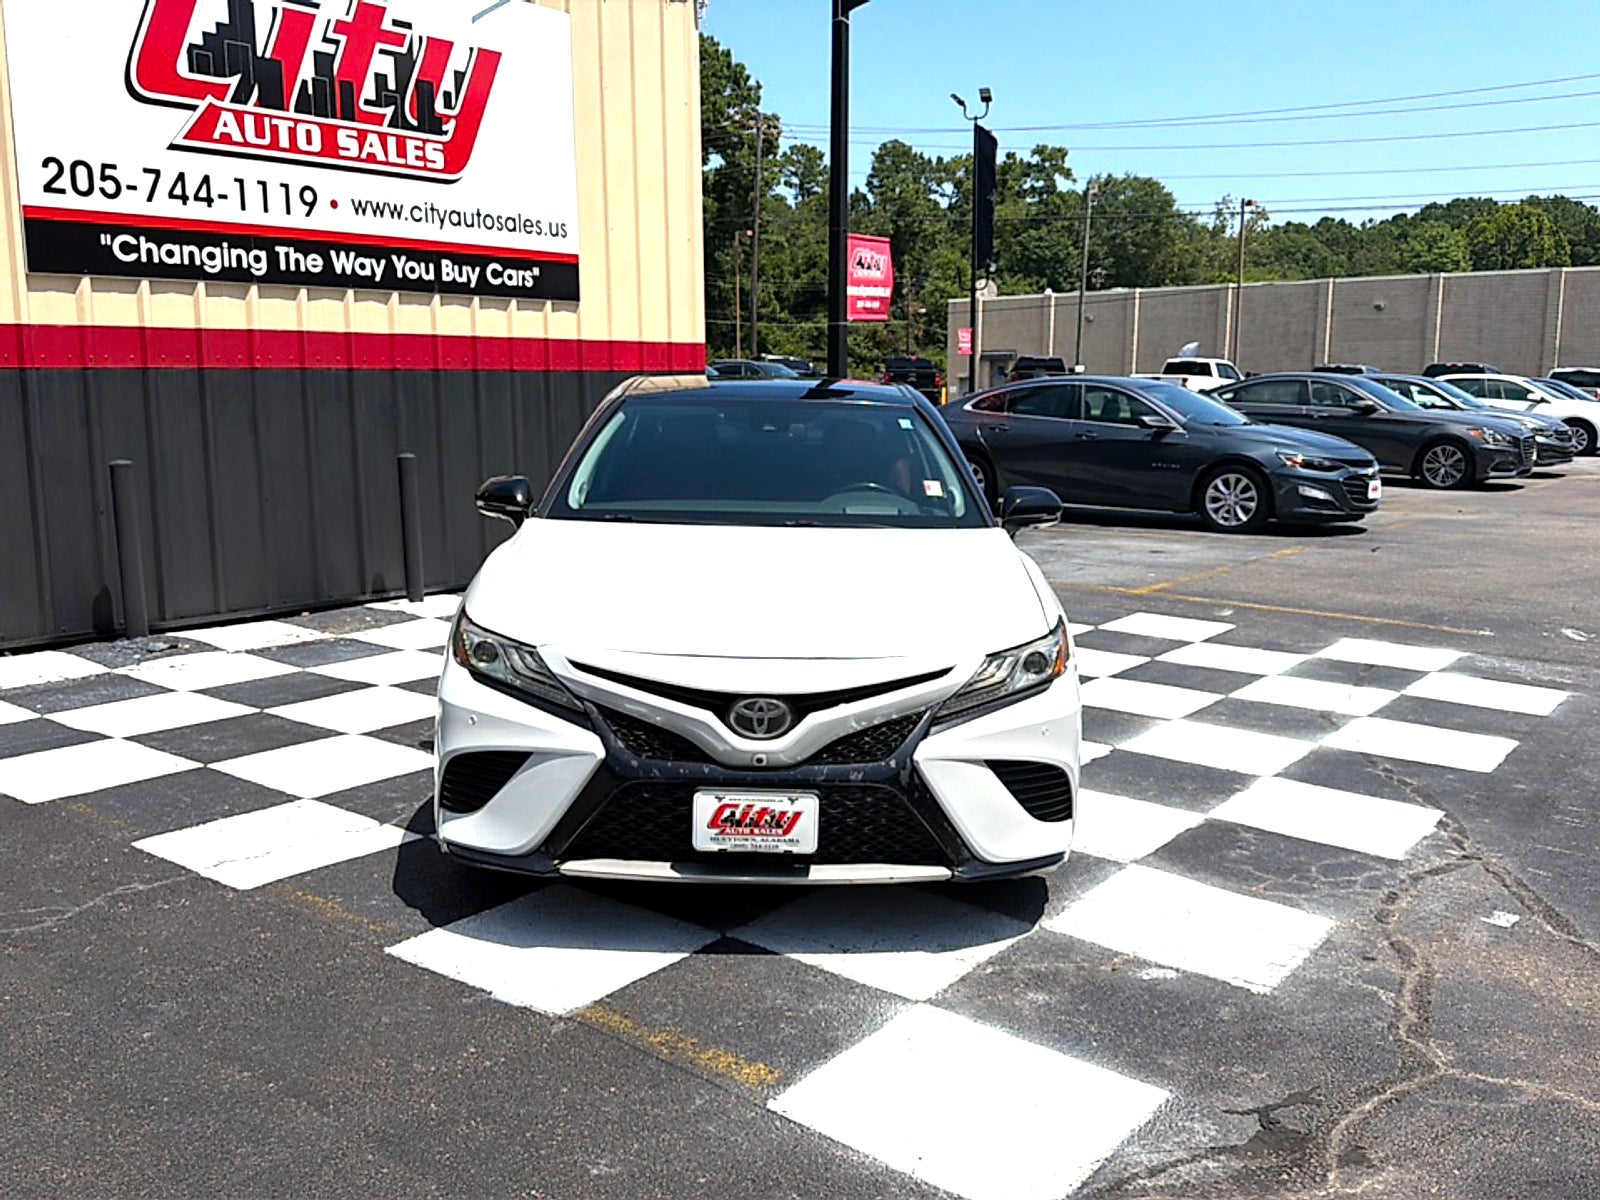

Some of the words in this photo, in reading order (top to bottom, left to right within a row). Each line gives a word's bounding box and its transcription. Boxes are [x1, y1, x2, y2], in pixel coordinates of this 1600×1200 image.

[126, 0, 502, 172] City
[212, 110, 322, 153] AUTO
[336, 128, 445, 170] SALES
[41, 156, 318, 218] 205-744-1119
[351, 198, 568, 239] www.cityautosales.us
[100, 233, 268, 276] "Changing
[275, 245, 324, 273] The
[330, 249, 386, 282] Way
[391, 254, 435, 281] You
[441, 259, 480, 288] Buy
[486, 262, 540, 288] Cars"
[707, 802, 804, 836] City
[724, 827, 751, 836] AUTO
